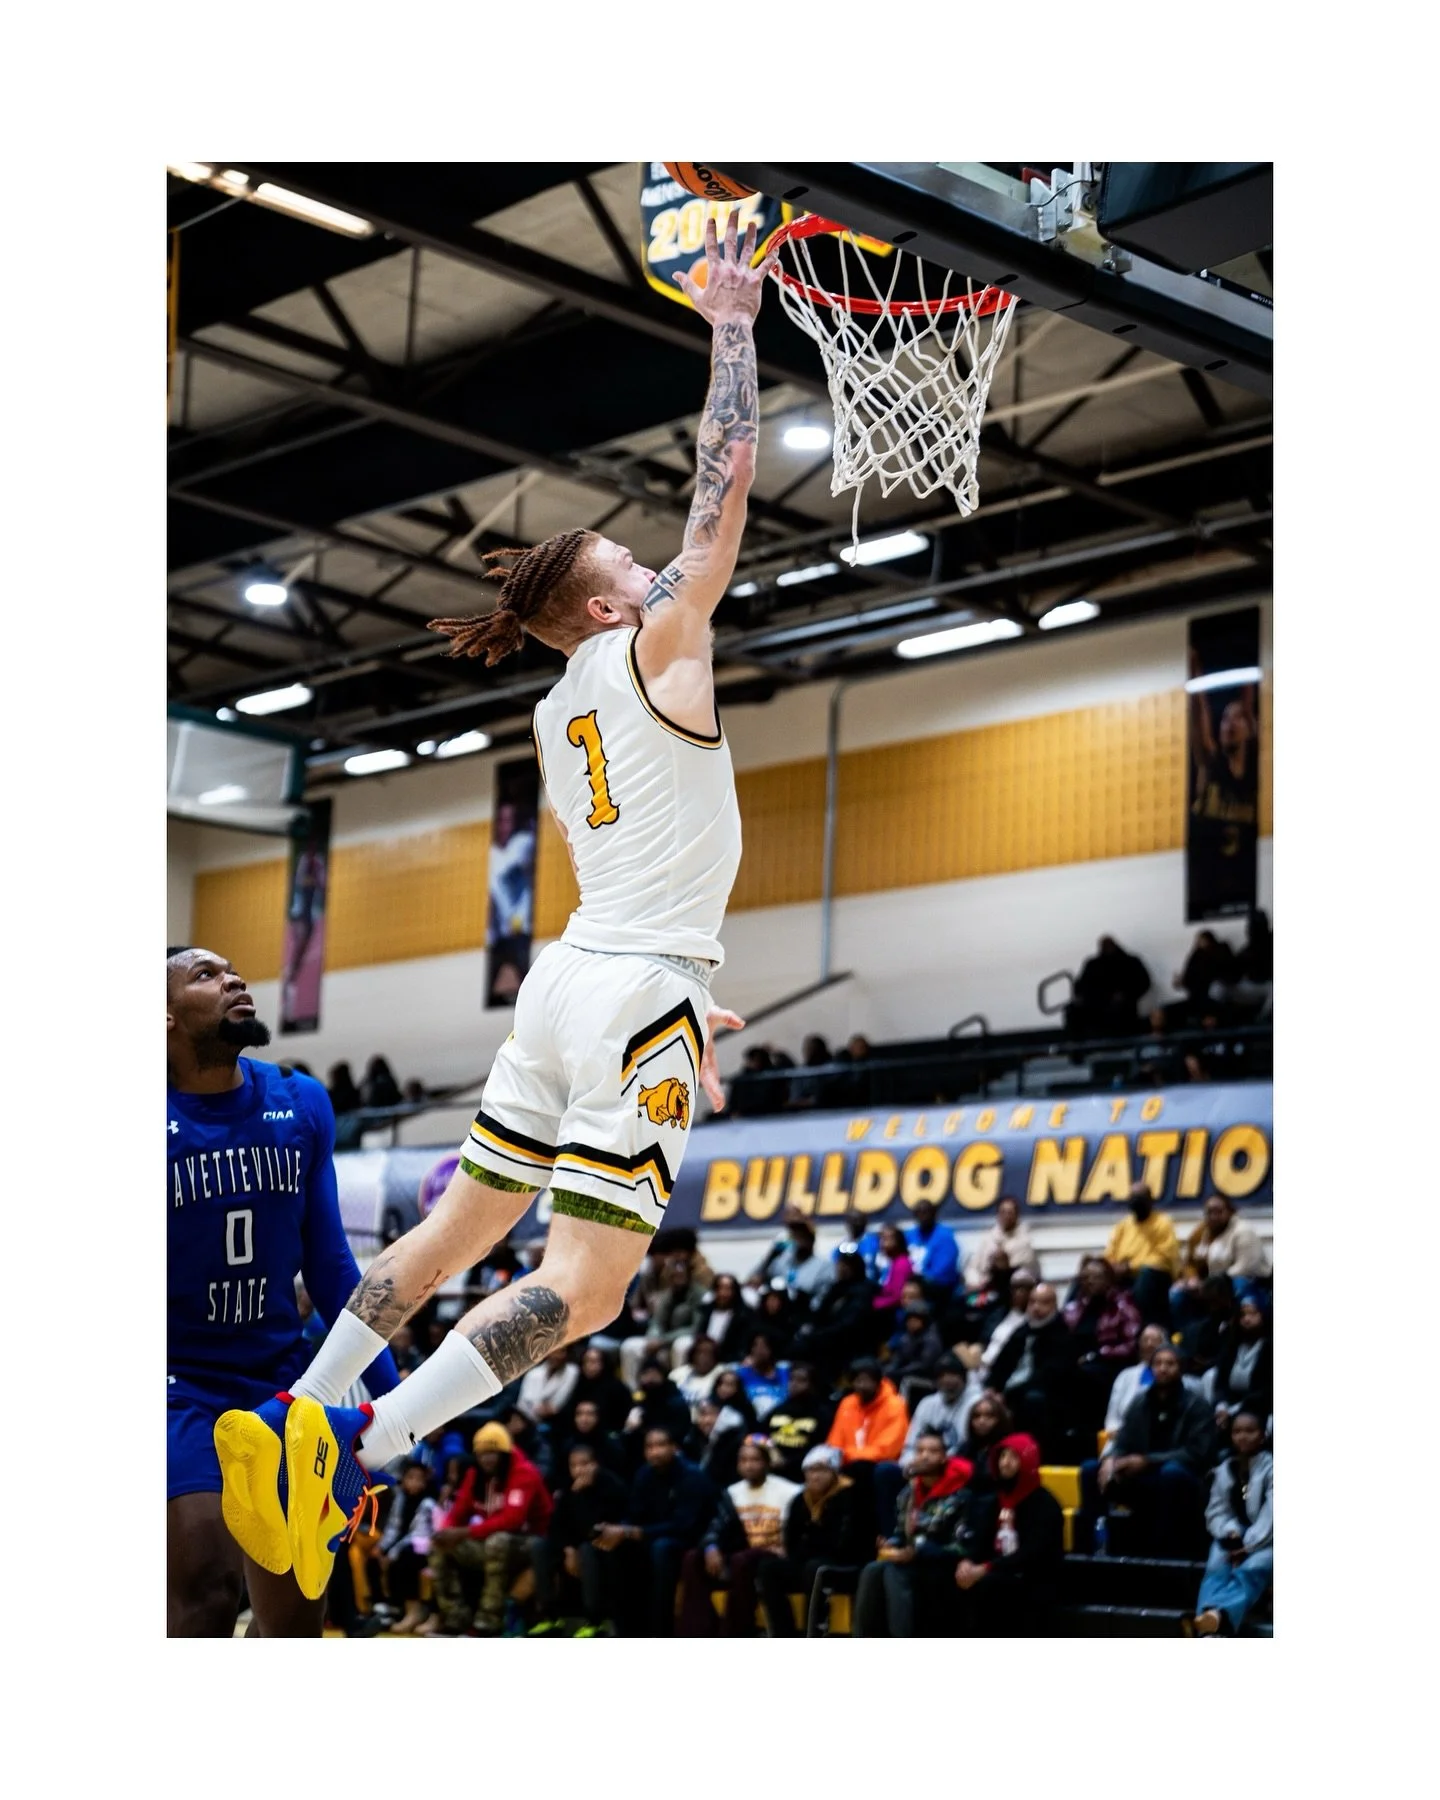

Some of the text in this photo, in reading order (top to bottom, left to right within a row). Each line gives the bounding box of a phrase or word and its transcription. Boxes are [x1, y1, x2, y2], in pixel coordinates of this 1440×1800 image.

[567, 709, 621, 829] 1
[263, 1109, 294, 1121] CIAA
[846, 1096, 1165, 1141] WELCOME TO
[174, 1146, 301, 1209] AYETTEVILLE
[699, 1123, 1270, 1222] BULLDOG NATIO
[226, 1208, 253, 1266] 0
[207, 1277, 267, 1324] STATE
